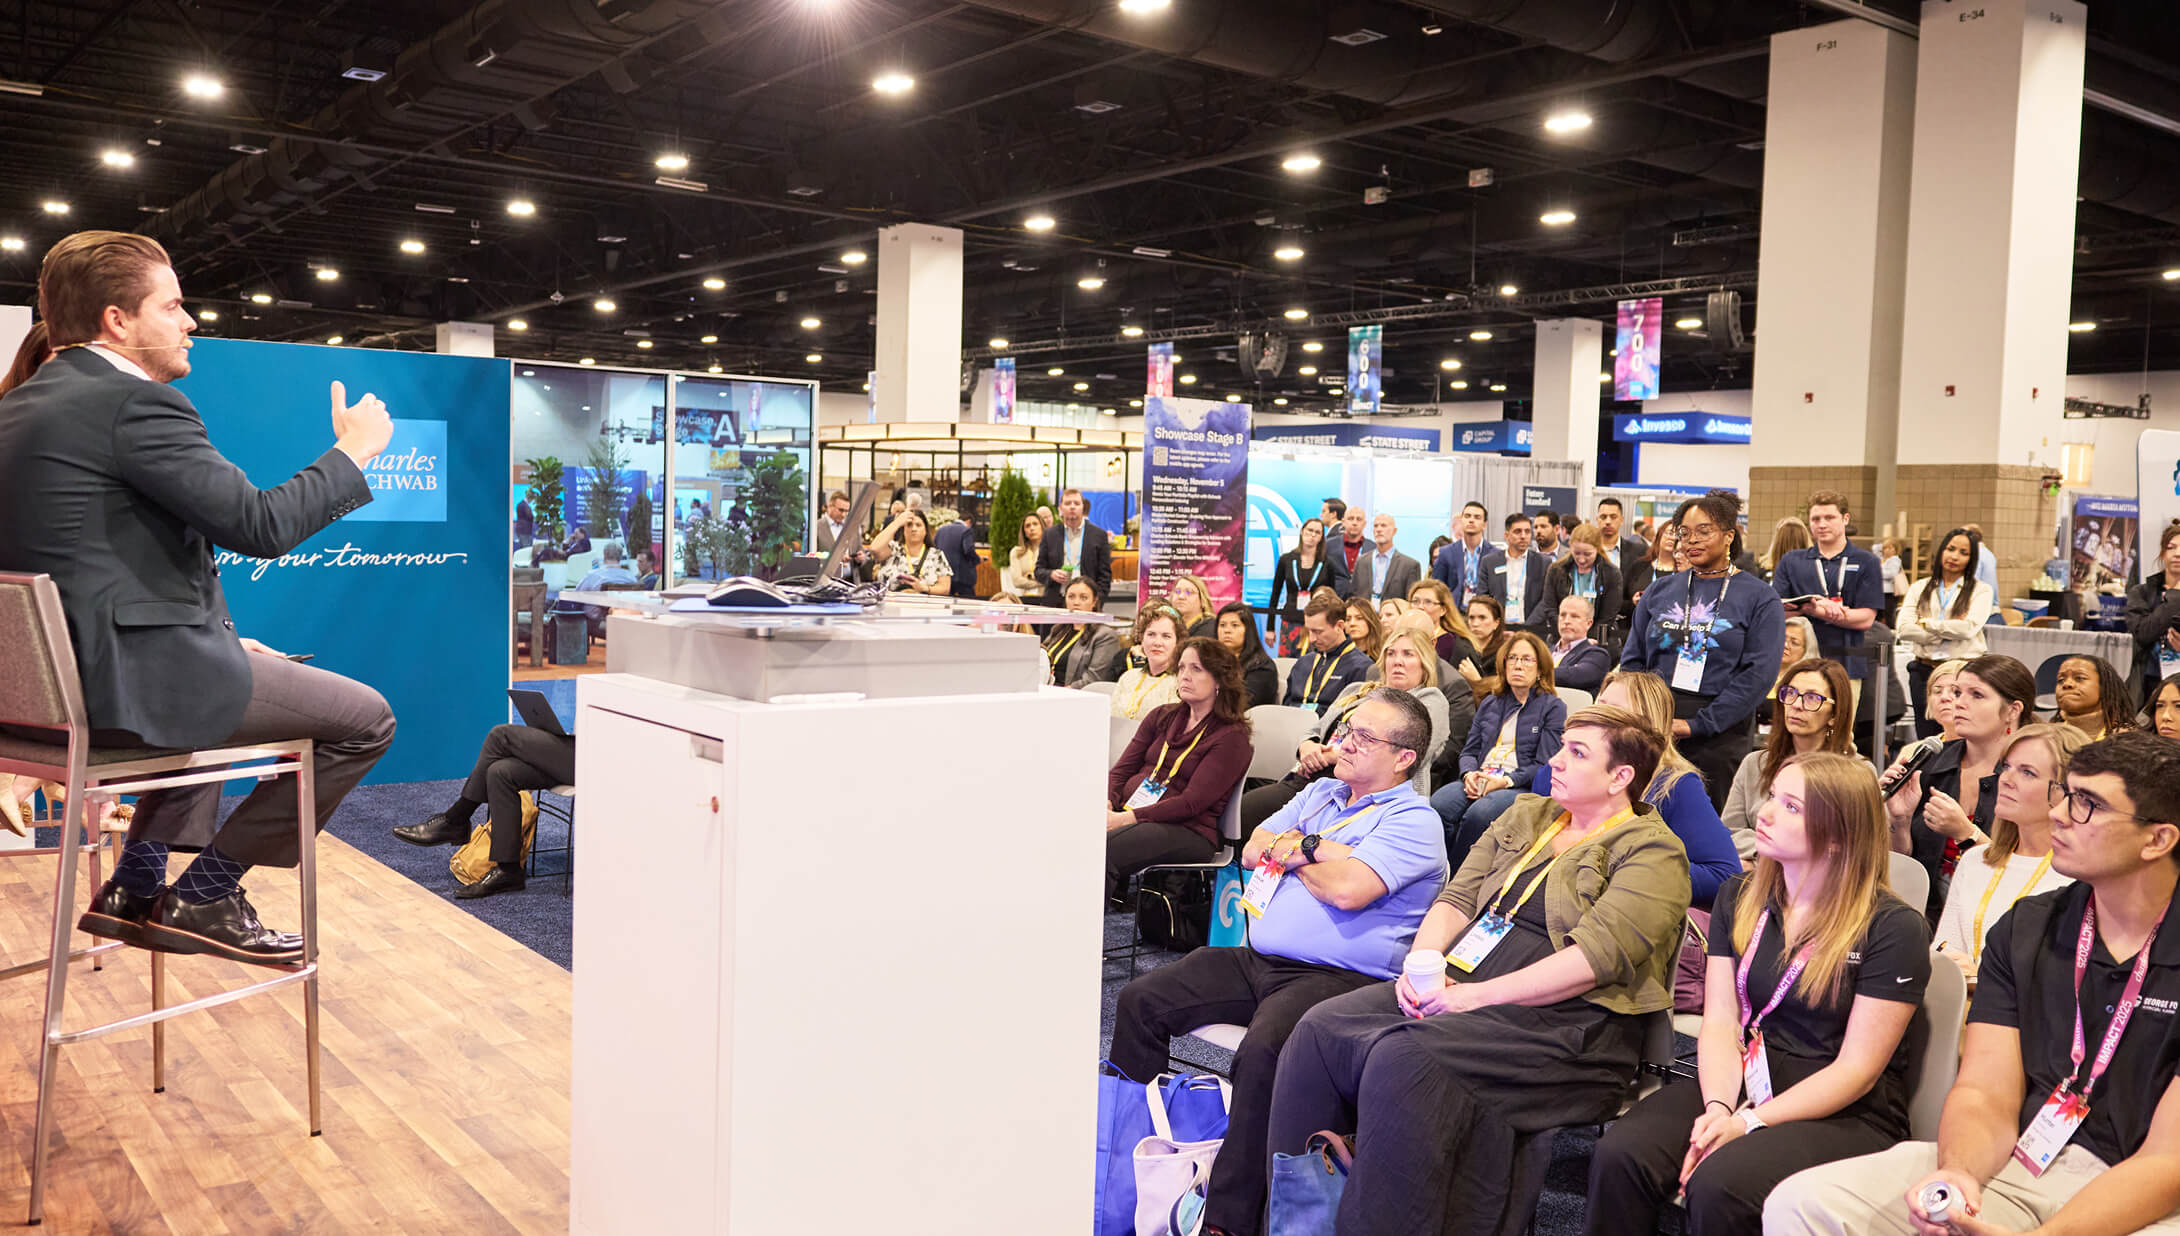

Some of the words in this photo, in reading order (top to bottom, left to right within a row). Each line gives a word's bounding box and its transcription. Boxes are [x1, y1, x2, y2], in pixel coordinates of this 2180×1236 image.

[1960, 9, 1984, 22] E-34
[1632, 314, 1645, 372] 700
[1359, 338, 1369, 390] 600
[655, 411, 714, 426] Sowcase
[713, 413, 737, 442] A
[1641, 419, 1687, 433] Invesco
[655, 424, 688, 440] Sge
[1154, 427, 1205, 442] Showcase
[1207, 431, 1234, 447] Stage
[1236, 433, 1244, 445] B
[1278, 436, 1302, 445] STATE
[1303, 435, 1337, 446] STREET
[1372, 436, 1398, 449] STATE
[1398, 438, 1430, 450] STREET
[363, 446, 437, 471] harles
[364, 473, 438, 490] CHWAB
[1190, 477, 1219, 487] November
[247, 553, 322, 581] your
[1662, 621, 1680, 630] Can
[2081, 906, 2095, 941] IMPACT
[2077, 942, 2090, 969] 2025
[1769, 977, 1791, 1008] IMPACT
[1788, 959, 1804, 979] 2025
[2143, 997, 2169, 1008] GEORGE
[2168, 1000, 2179, 1010] FO
[2098, 1022, 2121, 1066] IMPACT
[2114, 999, 2133, 1025] 2025
